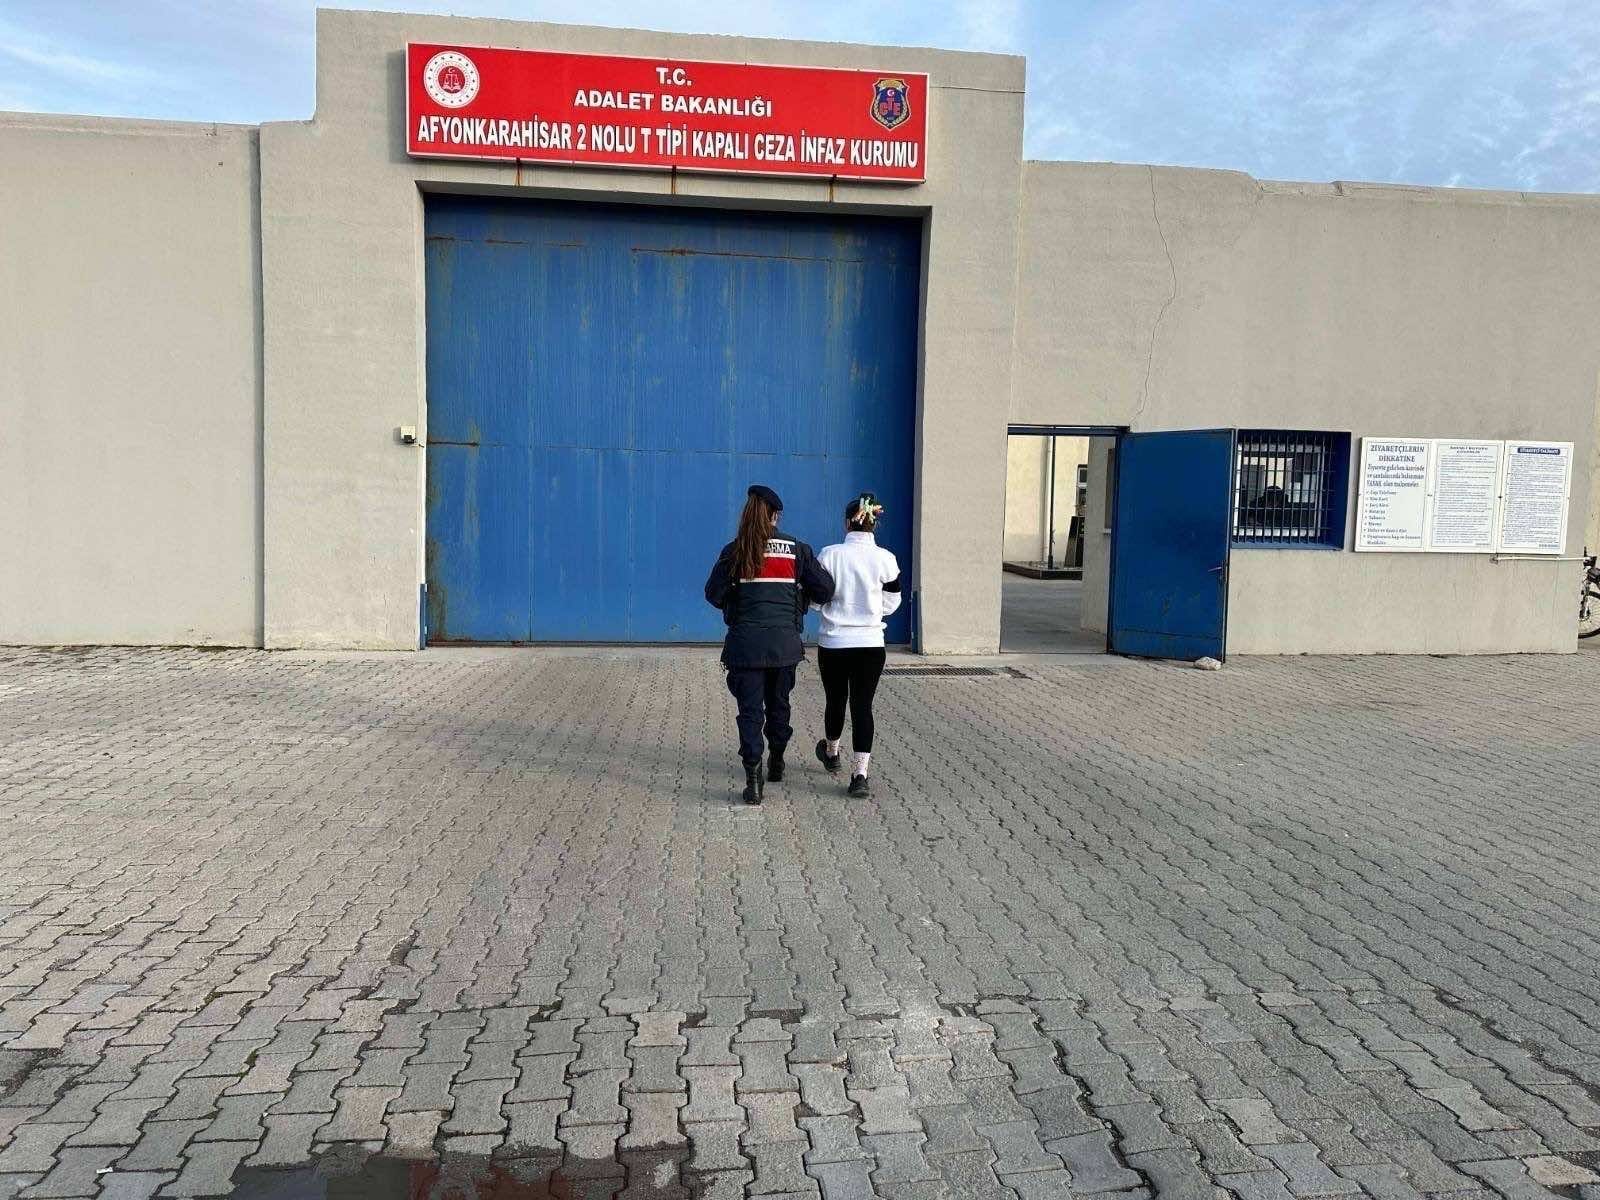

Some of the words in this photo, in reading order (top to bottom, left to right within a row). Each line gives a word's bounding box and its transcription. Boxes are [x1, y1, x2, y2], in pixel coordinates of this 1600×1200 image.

[655, 67, 693, 86] T.C.
[573, 89, 655, 110] ADALET
[660, 94, 773, 118] BAKANLIĞI
[417, 115, 572, 151] AFYONKARAHİSAR
[576, 123, 588, 151] 2
[591, 124, 636, 154] NOLU
[640, 127, 653, 155] T
[655, 122, 690, 157] TİPİ
[692, 130, 750, 161] KAPALI
[754, 133, 796, 163] CEZA
[800, 129, 846, 165] İNFAZ
[850, 139, 918, 168] KURUMU
[767, 543, 791, 554] ARMA
